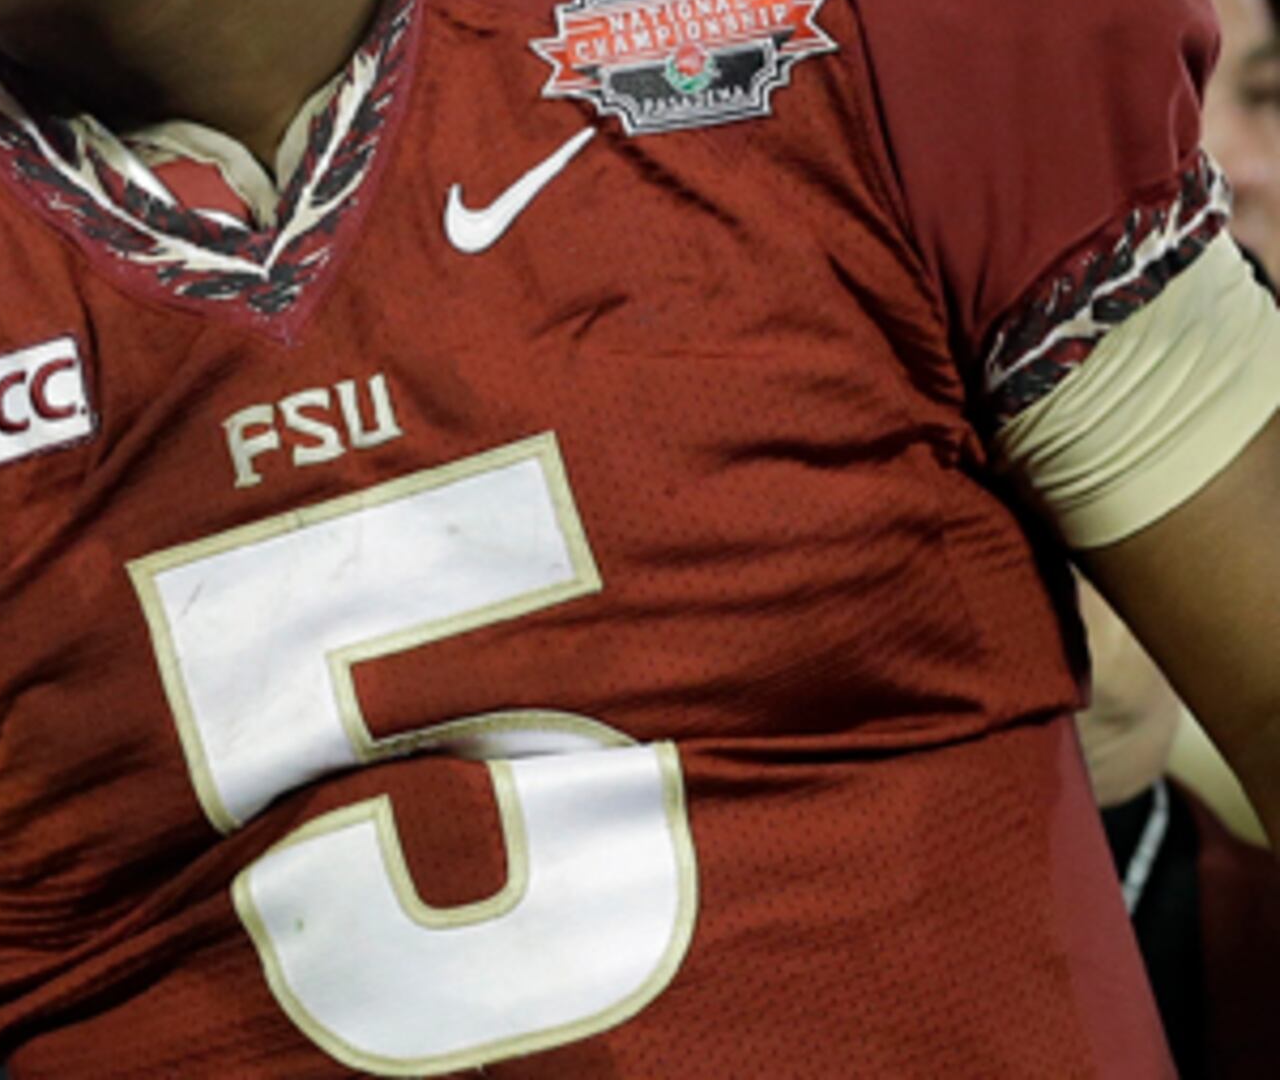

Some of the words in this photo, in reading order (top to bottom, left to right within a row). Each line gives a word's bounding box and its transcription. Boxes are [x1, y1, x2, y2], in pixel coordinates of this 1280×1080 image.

[574, 3, 788, 60] CHAMPIONSHIP
[222, 373, 403, 488] FSU
[125, 430, 699, 1078] 5
